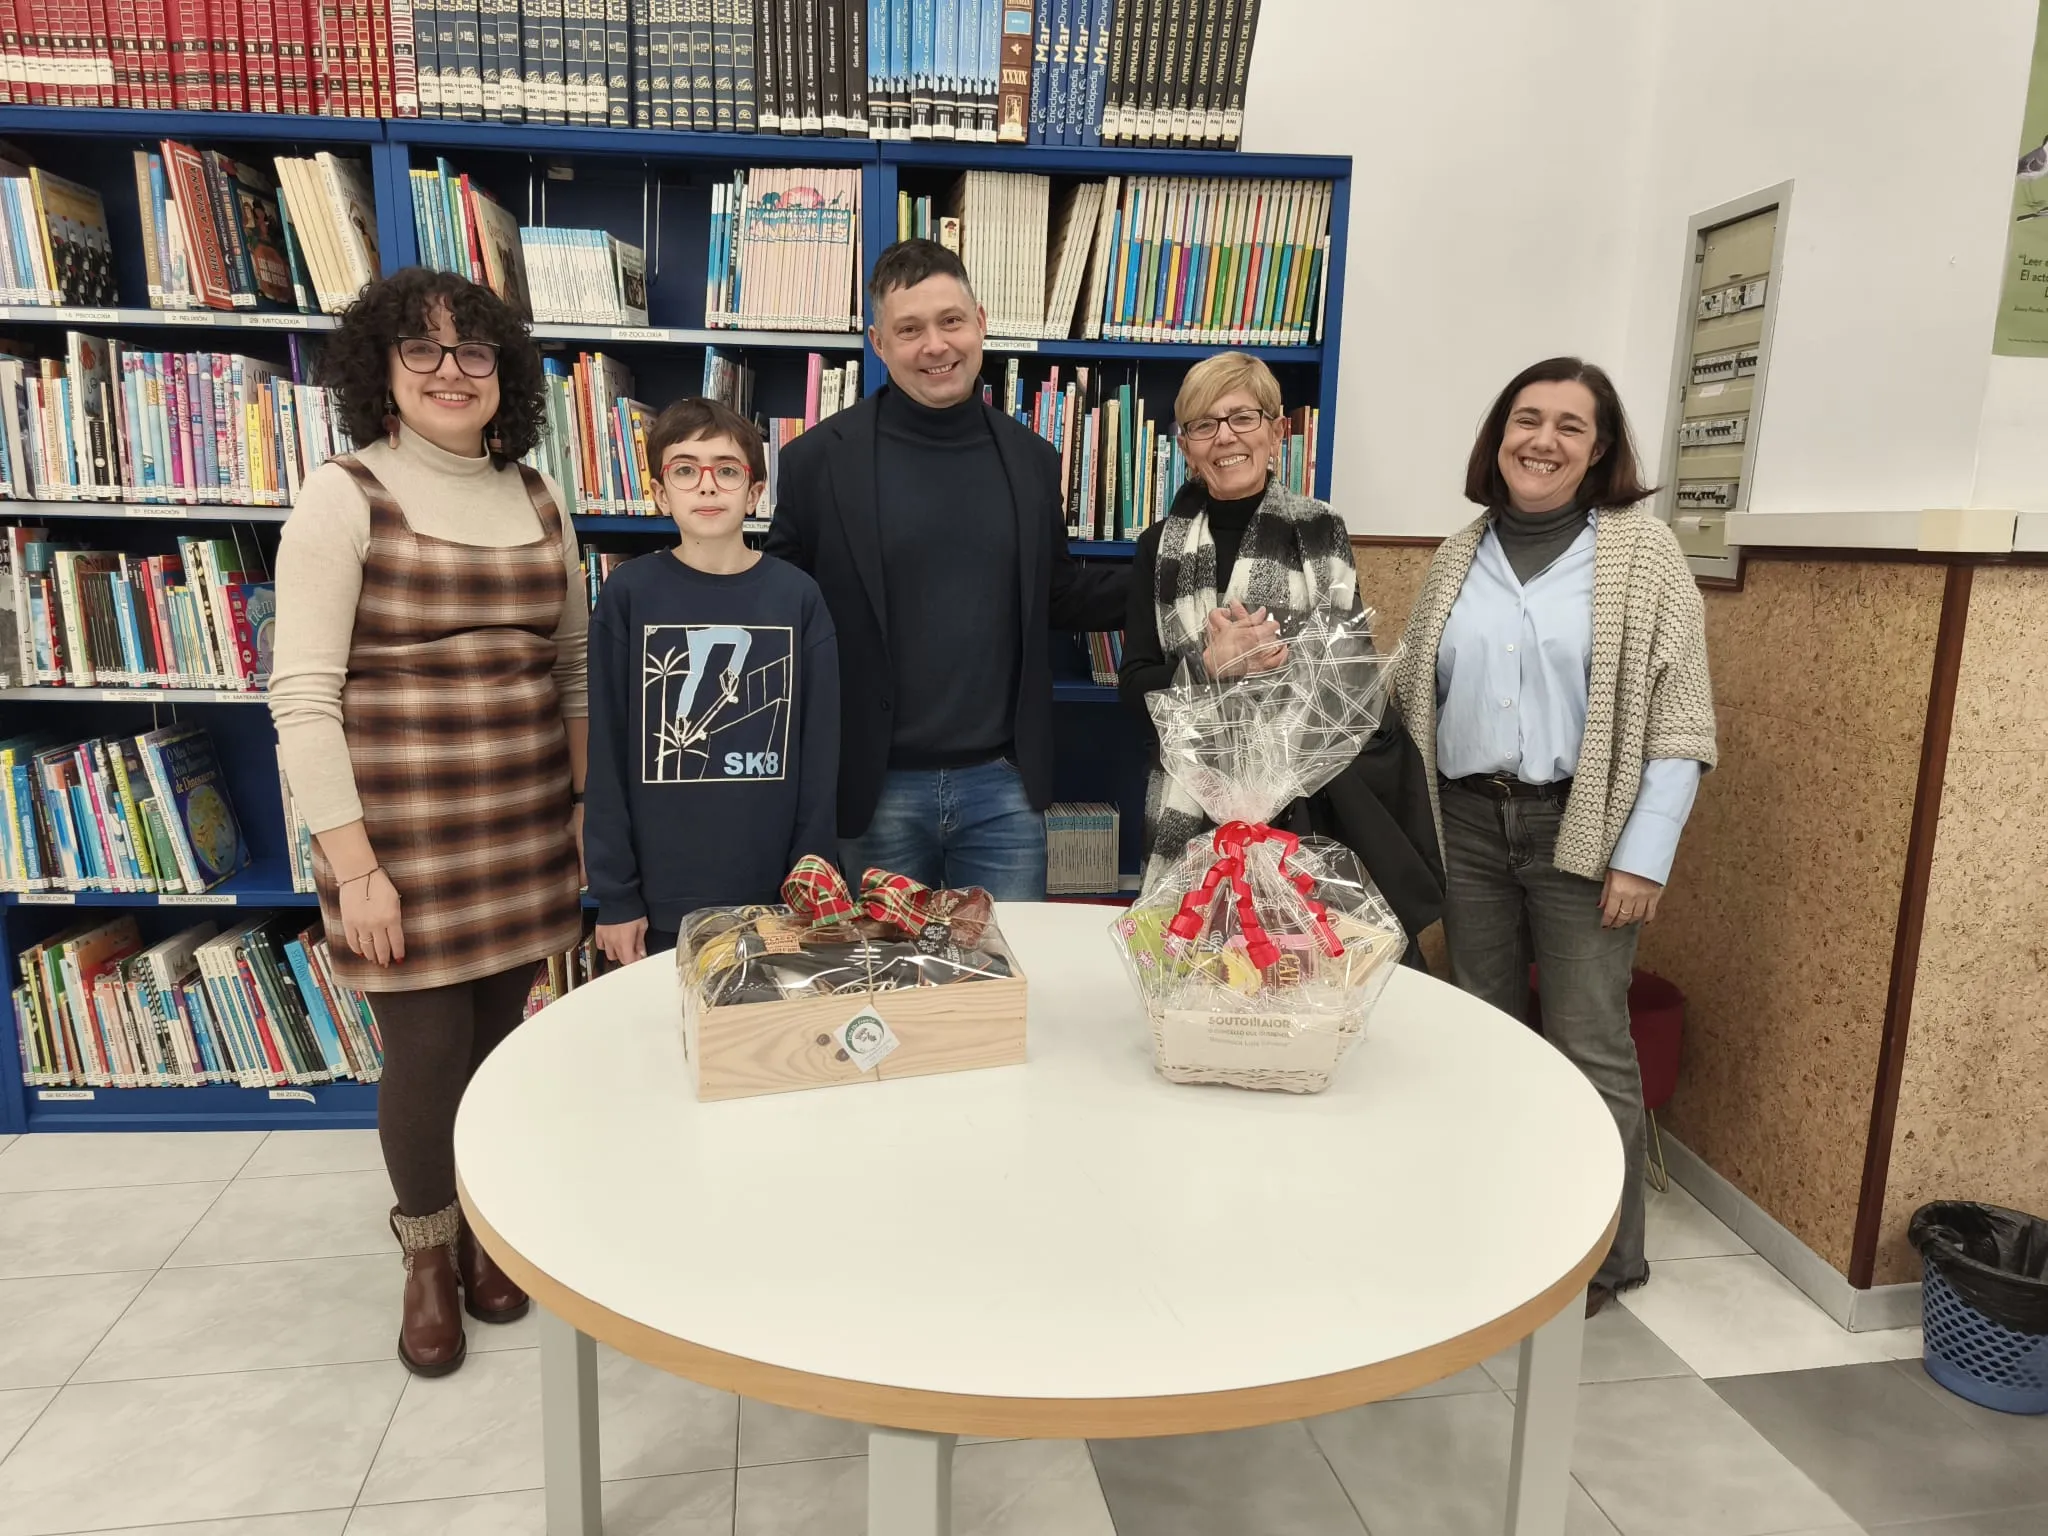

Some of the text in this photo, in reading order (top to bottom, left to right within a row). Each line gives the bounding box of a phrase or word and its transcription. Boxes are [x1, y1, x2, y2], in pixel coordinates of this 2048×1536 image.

[1116, 21, 1124, 37] DEL
[1134, 21, 1142, 38] DEL
[1152, 21, 1160, 37] DEL
[1169, 22, 1178, 38] DEL
[1187, 22, 1196, 39] DEL
[1112, 40, 1122, 84] ANIMALES
[1200, 41, 1212, 86] ANIMALES
[1206, 22, 1214, 40] DEL
[1216, 41, 1229, 86] ANIMALES
[1223, 22, 1232, 39] DEL
[1234, 41, 1248, 86] ANIMALES
[1241, 23, 1250, 40] DEL
[1129, 40, 1140, 85] ANIMALES
[1147, 40, 1158, 85] ANIMALES
[1164, 40, 1176, 85] ANIMALES
[1182, 41, 1193, 85] ANIMALES
[1002, 69, 1027, 85] XXXIX
[1029, 68, 1041, 124] Enciclopedia
[1035, 27, 1050, 62] Mar
[1047, 68, 1060, 124] Enciclopedia
[1054, 28, 1070, 63] Mar
[1066, 68, 1079, 125] Enciclopedia
[1074, 28, 1090, 63] Mar
[1086, 71, 1099, 126] Enciclopedia
[1094, 32, 1110, 65] Mar
[764, 94, 774, 102] 32
[786, 94, 794, 102] 33
[807, 92, 816, 101] 34
[829, 94, 838, 102] 17
[853, 94, 861, 102] 15
[1112, 92, 1116, 101] 1
[1129, 92, 1135, 101] 2
[1146, 92, 1152, 102] 3
[1163, 93, 1169, 102] 4
[1181, 94, 1187, 102] 5
[1198, 94, 1204, 102] 6
[1216, 94, 1221, 102] 7
[1233, 94, 1239, 103] 8
[2020, 269, 2030, 281] El
[724, 752, 779, 775] SK8
